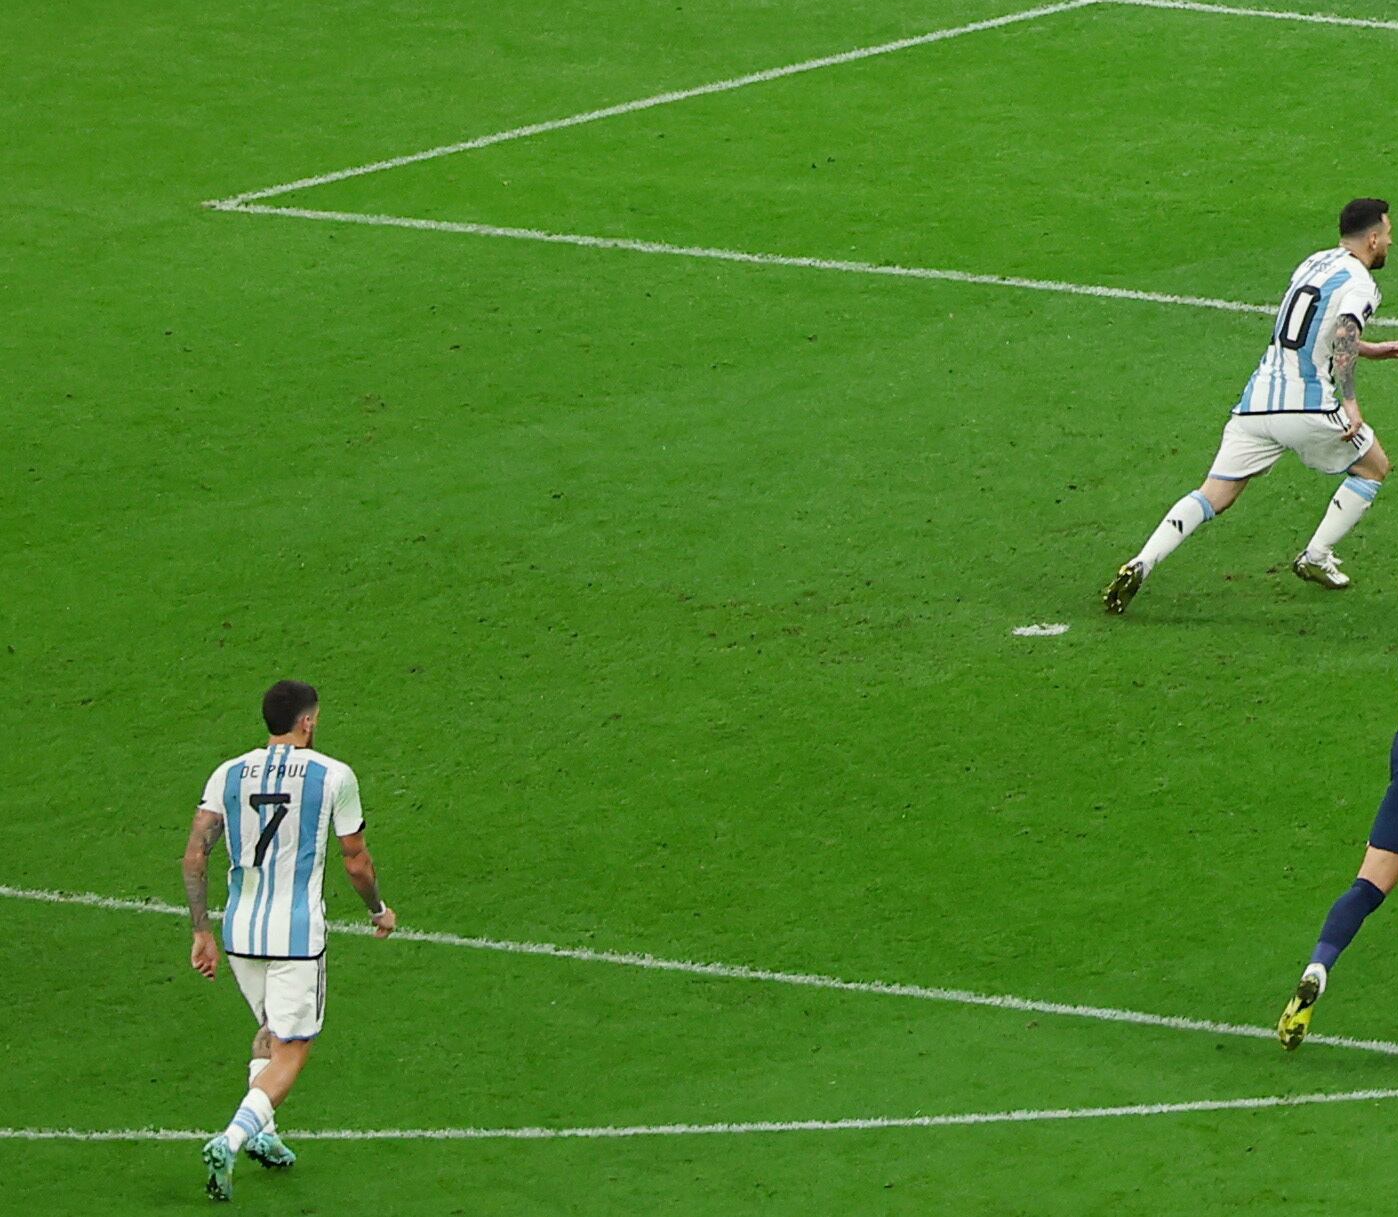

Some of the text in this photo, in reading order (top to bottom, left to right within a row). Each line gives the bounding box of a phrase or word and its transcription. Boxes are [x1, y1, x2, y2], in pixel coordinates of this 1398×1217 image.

[1277, 284, 1321, 351] 0
[240, 763, 308, 780] DE PAUL
[249, 793, 292, 867] 7
